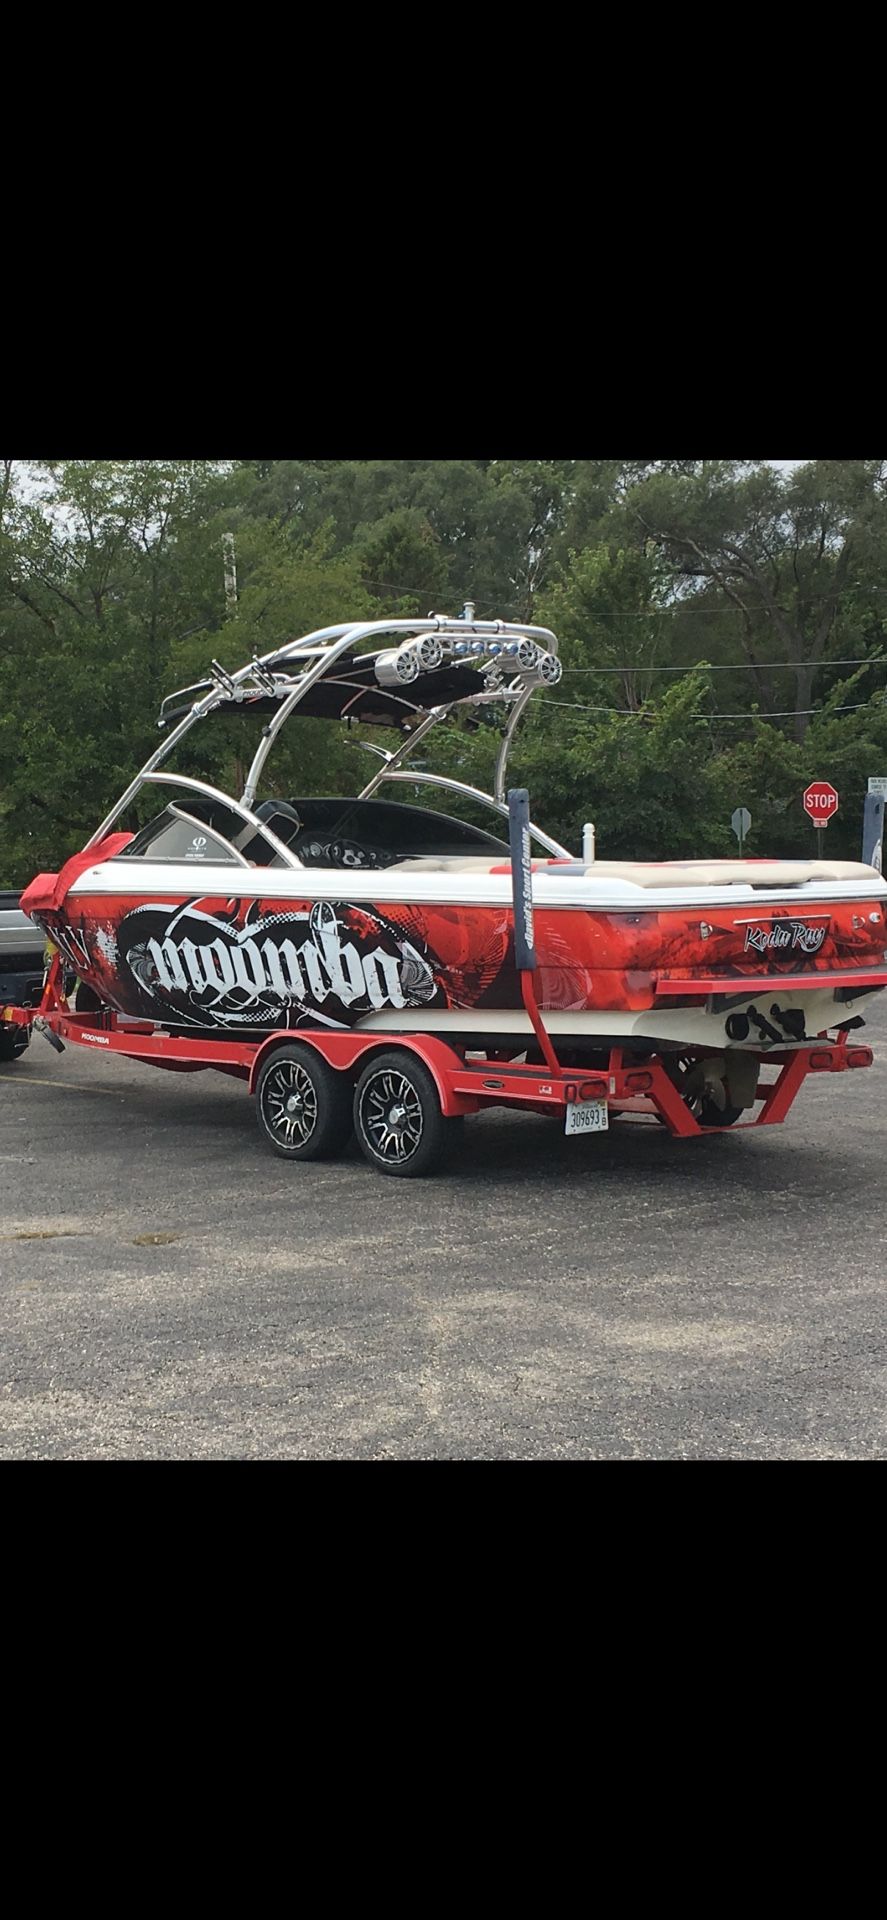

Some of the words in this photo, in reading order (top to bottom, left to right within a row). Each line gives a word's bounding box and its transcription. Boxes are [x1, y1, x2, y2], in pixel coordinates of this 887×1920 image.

[806, 794, 836, 808] STOP
[521, 826, 531, 867] Center
[522, 867, 532, 900] Sport
[523, 900, 533, 942] David's
[790, 922, 825, 952] Ray
[147, 920, 410, 1009] moomba
[81, 1032, 110, 1045] MOOMBA
[570, 1109, 600, 1128] 309693
